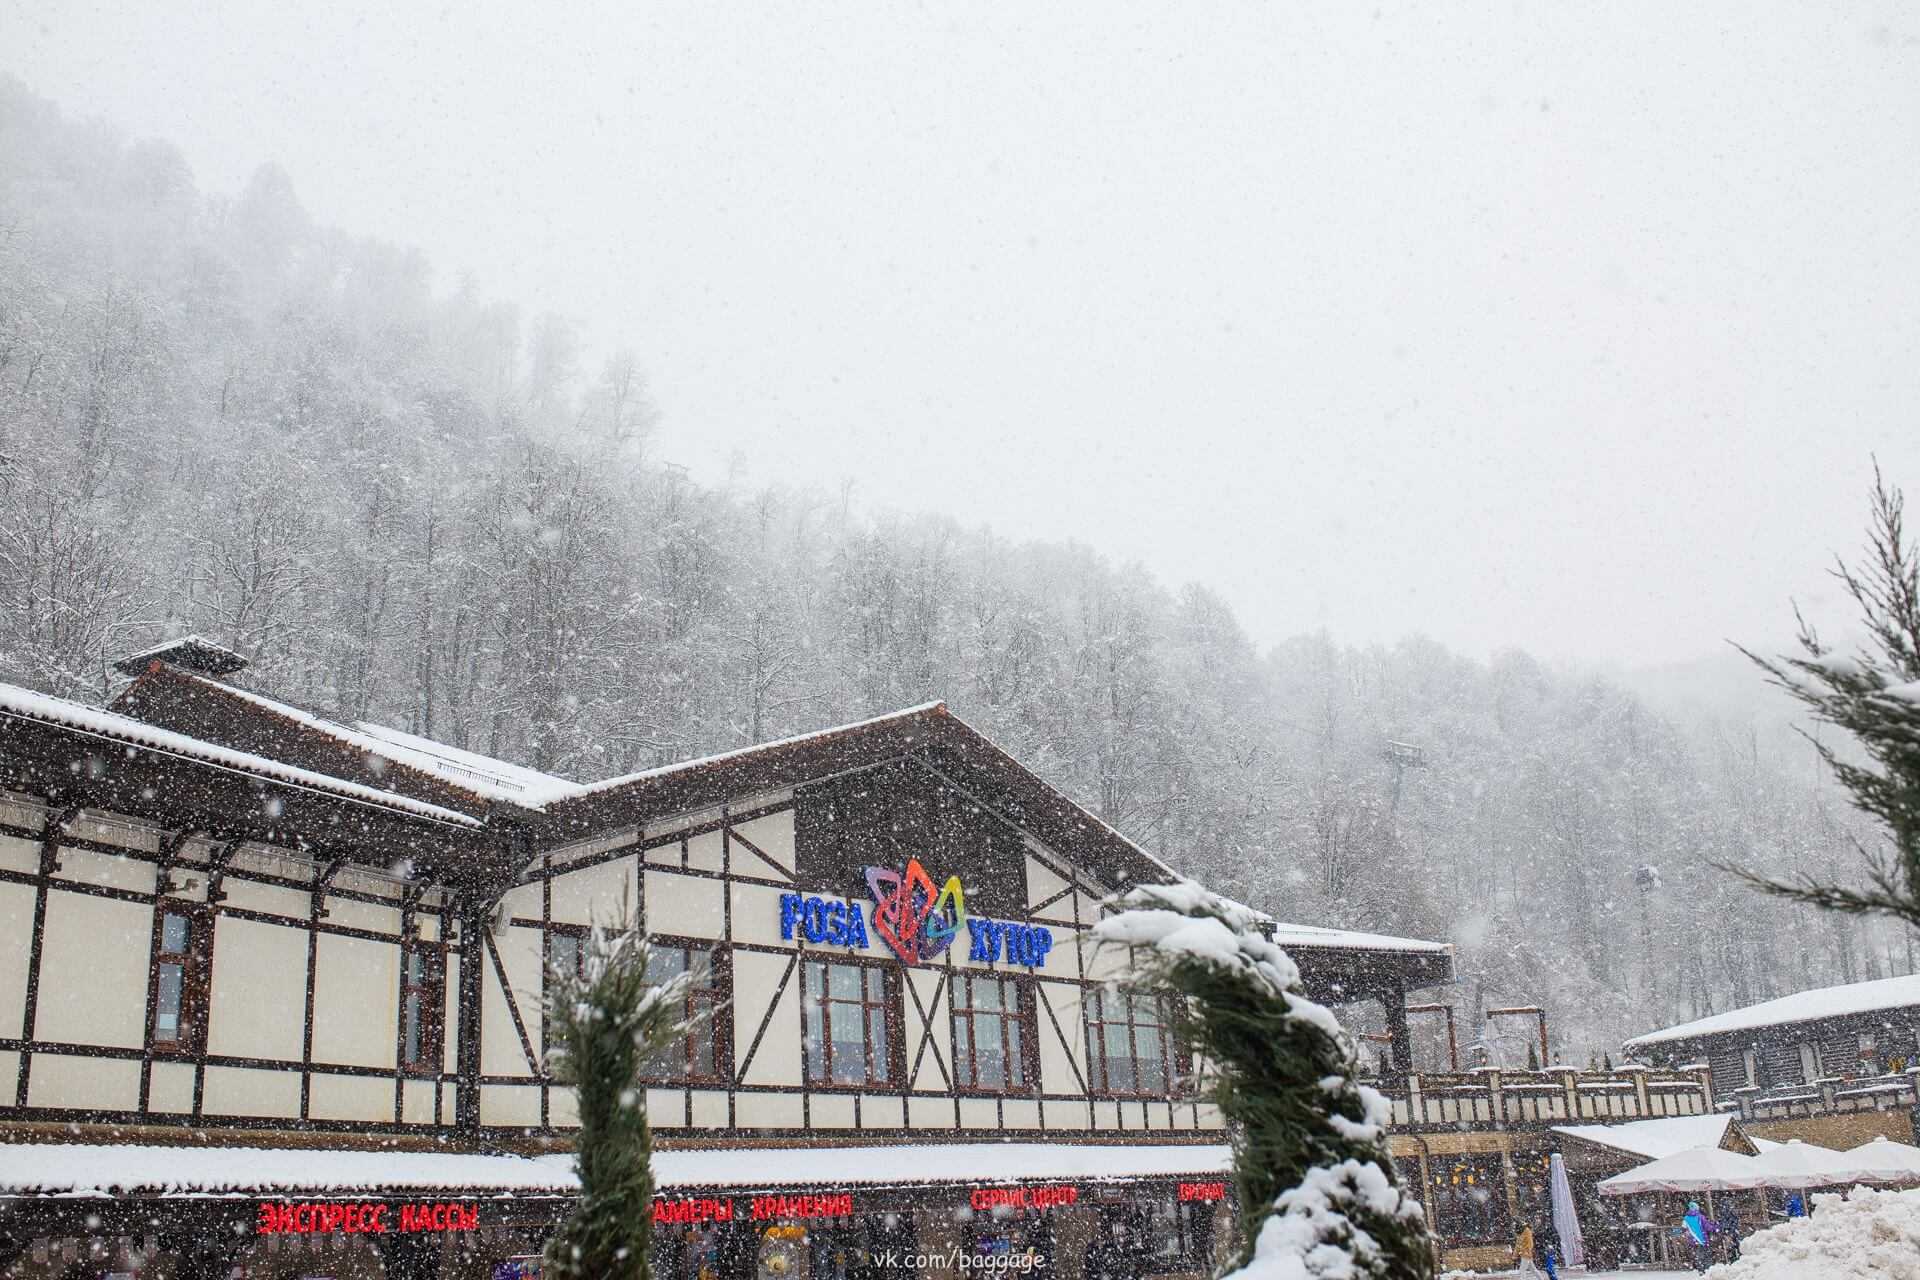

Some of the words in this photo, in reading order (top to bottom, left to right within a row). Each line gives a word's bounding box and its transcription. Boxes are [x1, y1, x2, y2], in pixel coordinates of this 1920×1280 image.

[780, 893, 869, 949] РОЗА
[967, 918, 1054, 967] ХУТОР
[256, 1203, 388, 1233] ЭКСПРЕСС
[400, 1203, 479, 1232] КАССЫ
[644, 1199, 732, 1224] АМЕРЫ
[752, 1195, 853, 1220] ХРАНЕНИЯ
